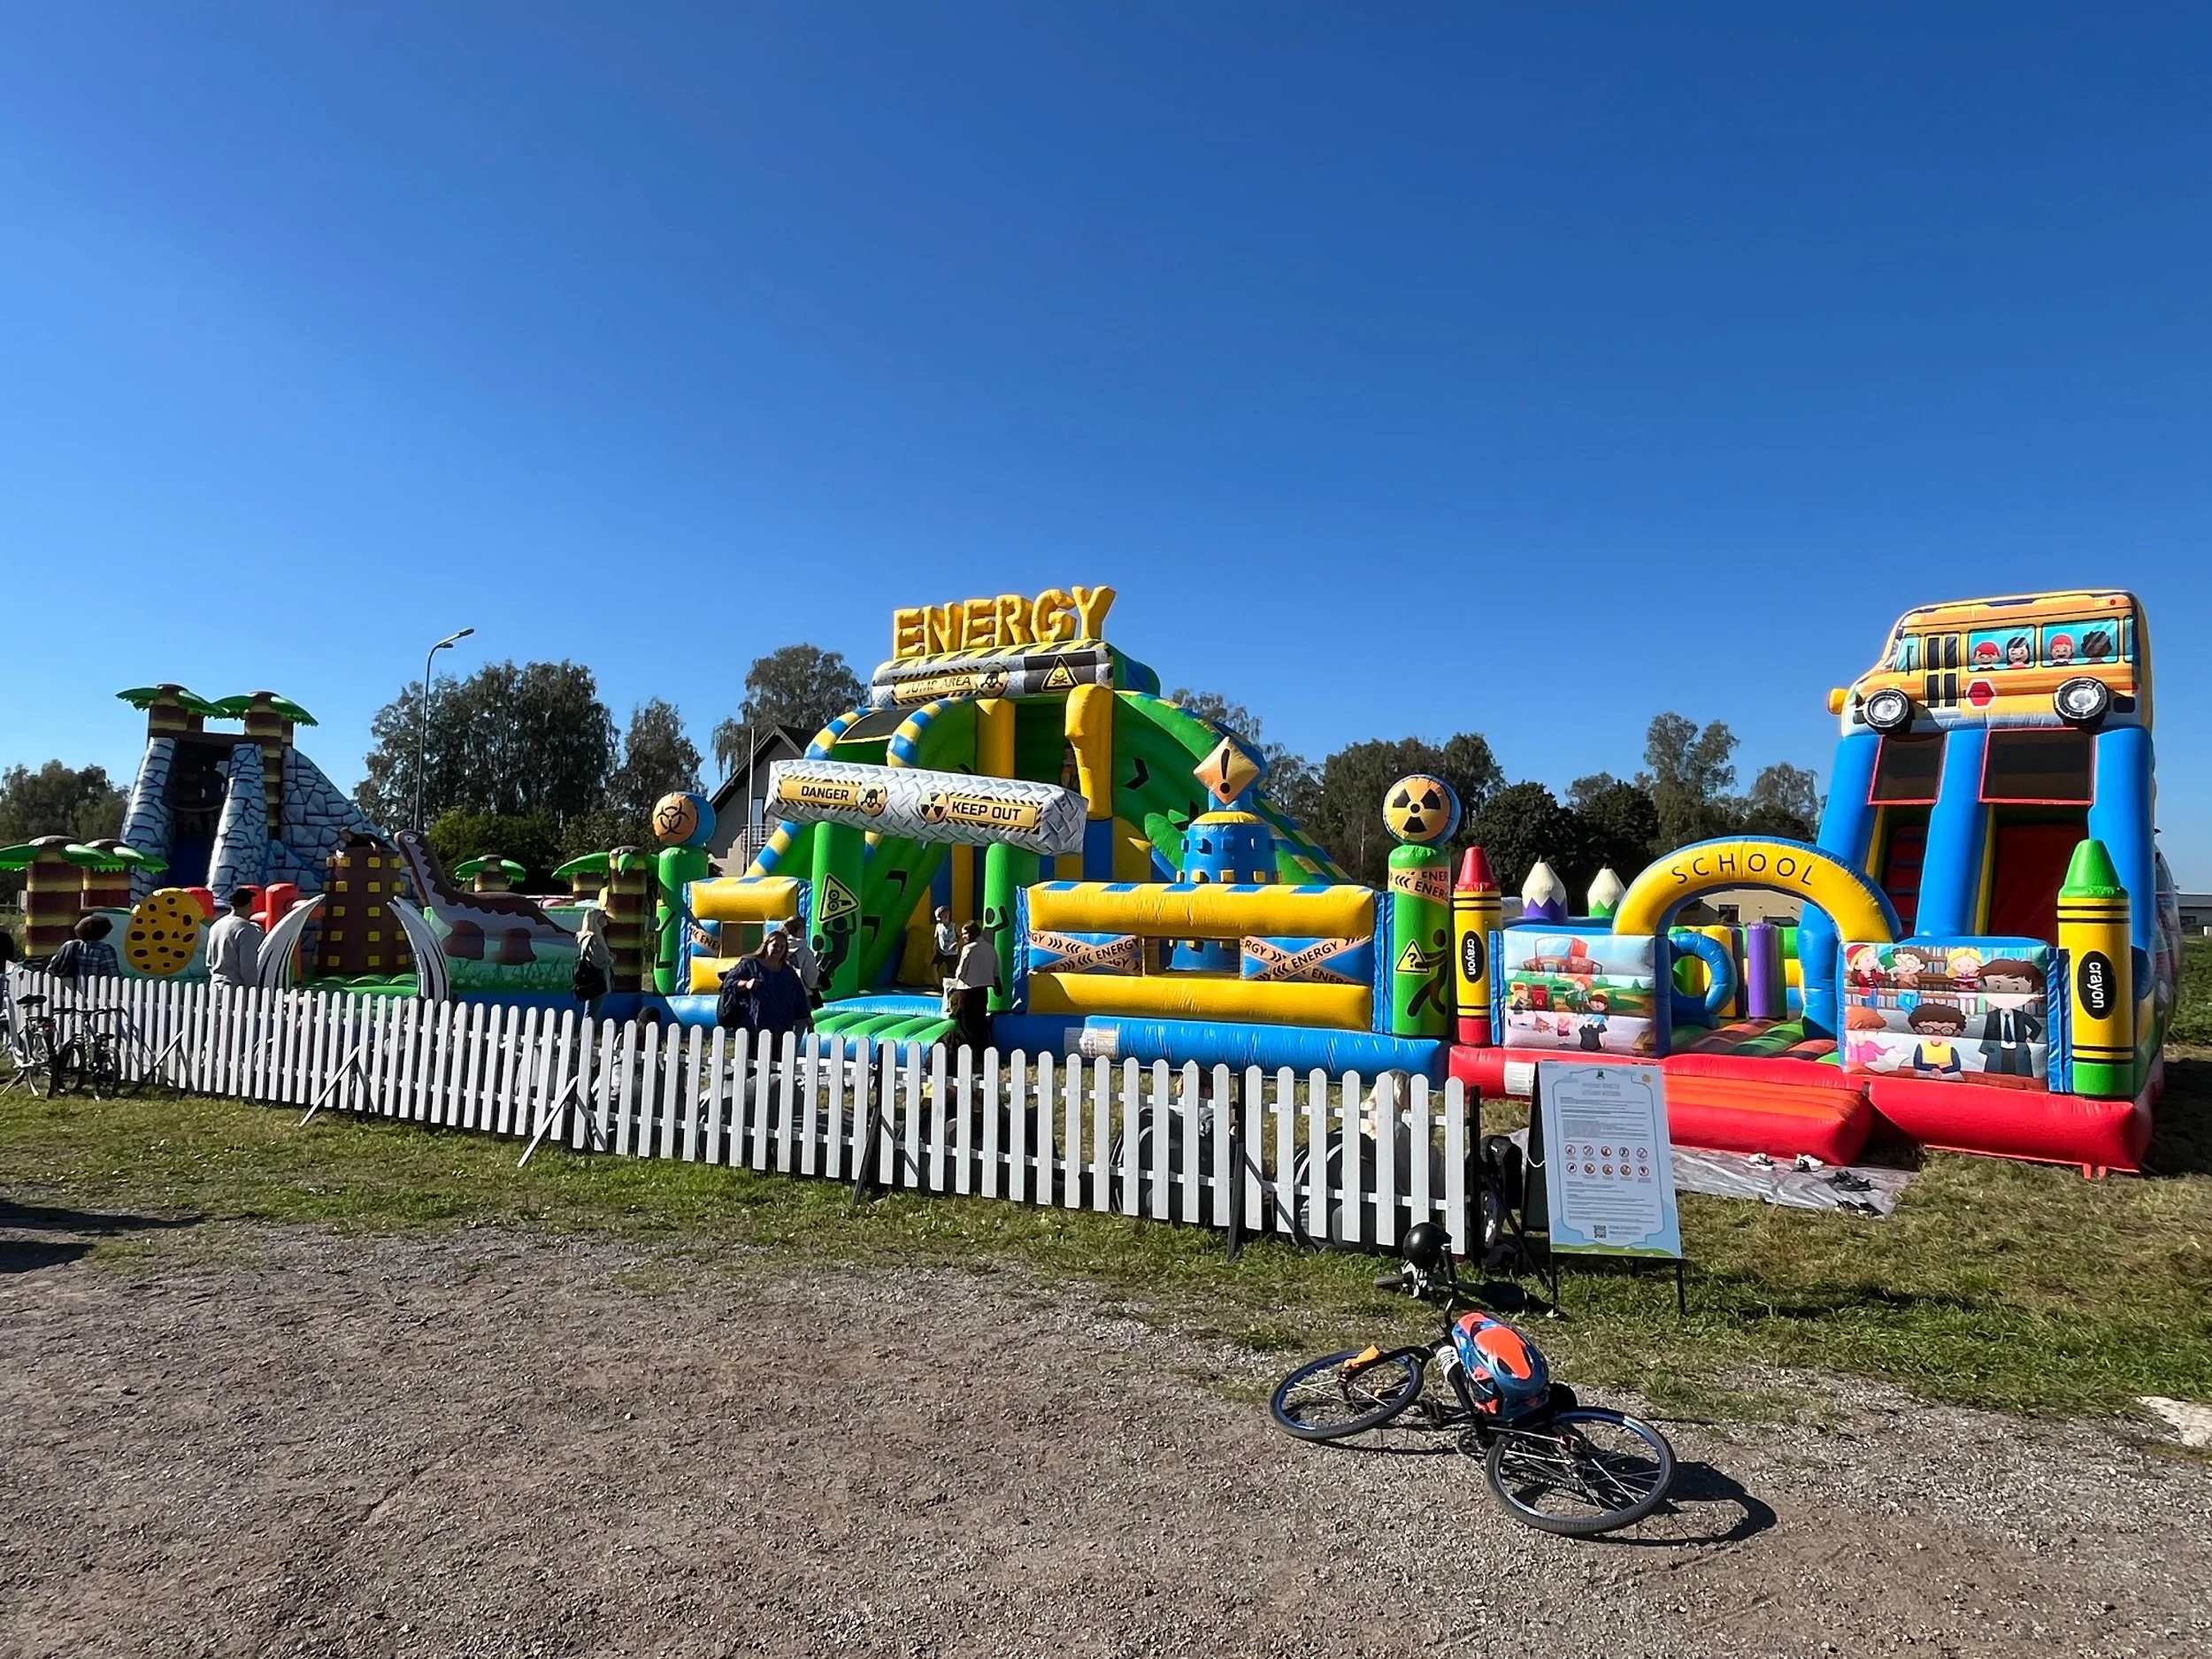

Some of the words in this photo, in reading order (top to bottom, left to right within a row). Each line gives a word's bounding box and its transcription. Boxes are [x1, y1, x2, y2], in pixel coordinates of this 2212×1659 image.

[894, 585, 1116, 658] ENERGY
[941, 676, 972, 689] AREA
[801, 785, 849, 801] DANGER
[952, 801, 988, 816] KEEP
[992, 806, 1022, 821] OUT
[1671, 853, 1813, 887] SCHOOL
[1095, 937, 1140, 960] ENERGY
[1291, 941, 1338, 970] ENERGY
[1464, 938, 1477, 976] crayon
[2086, 962, 2105, 1009] crayon
